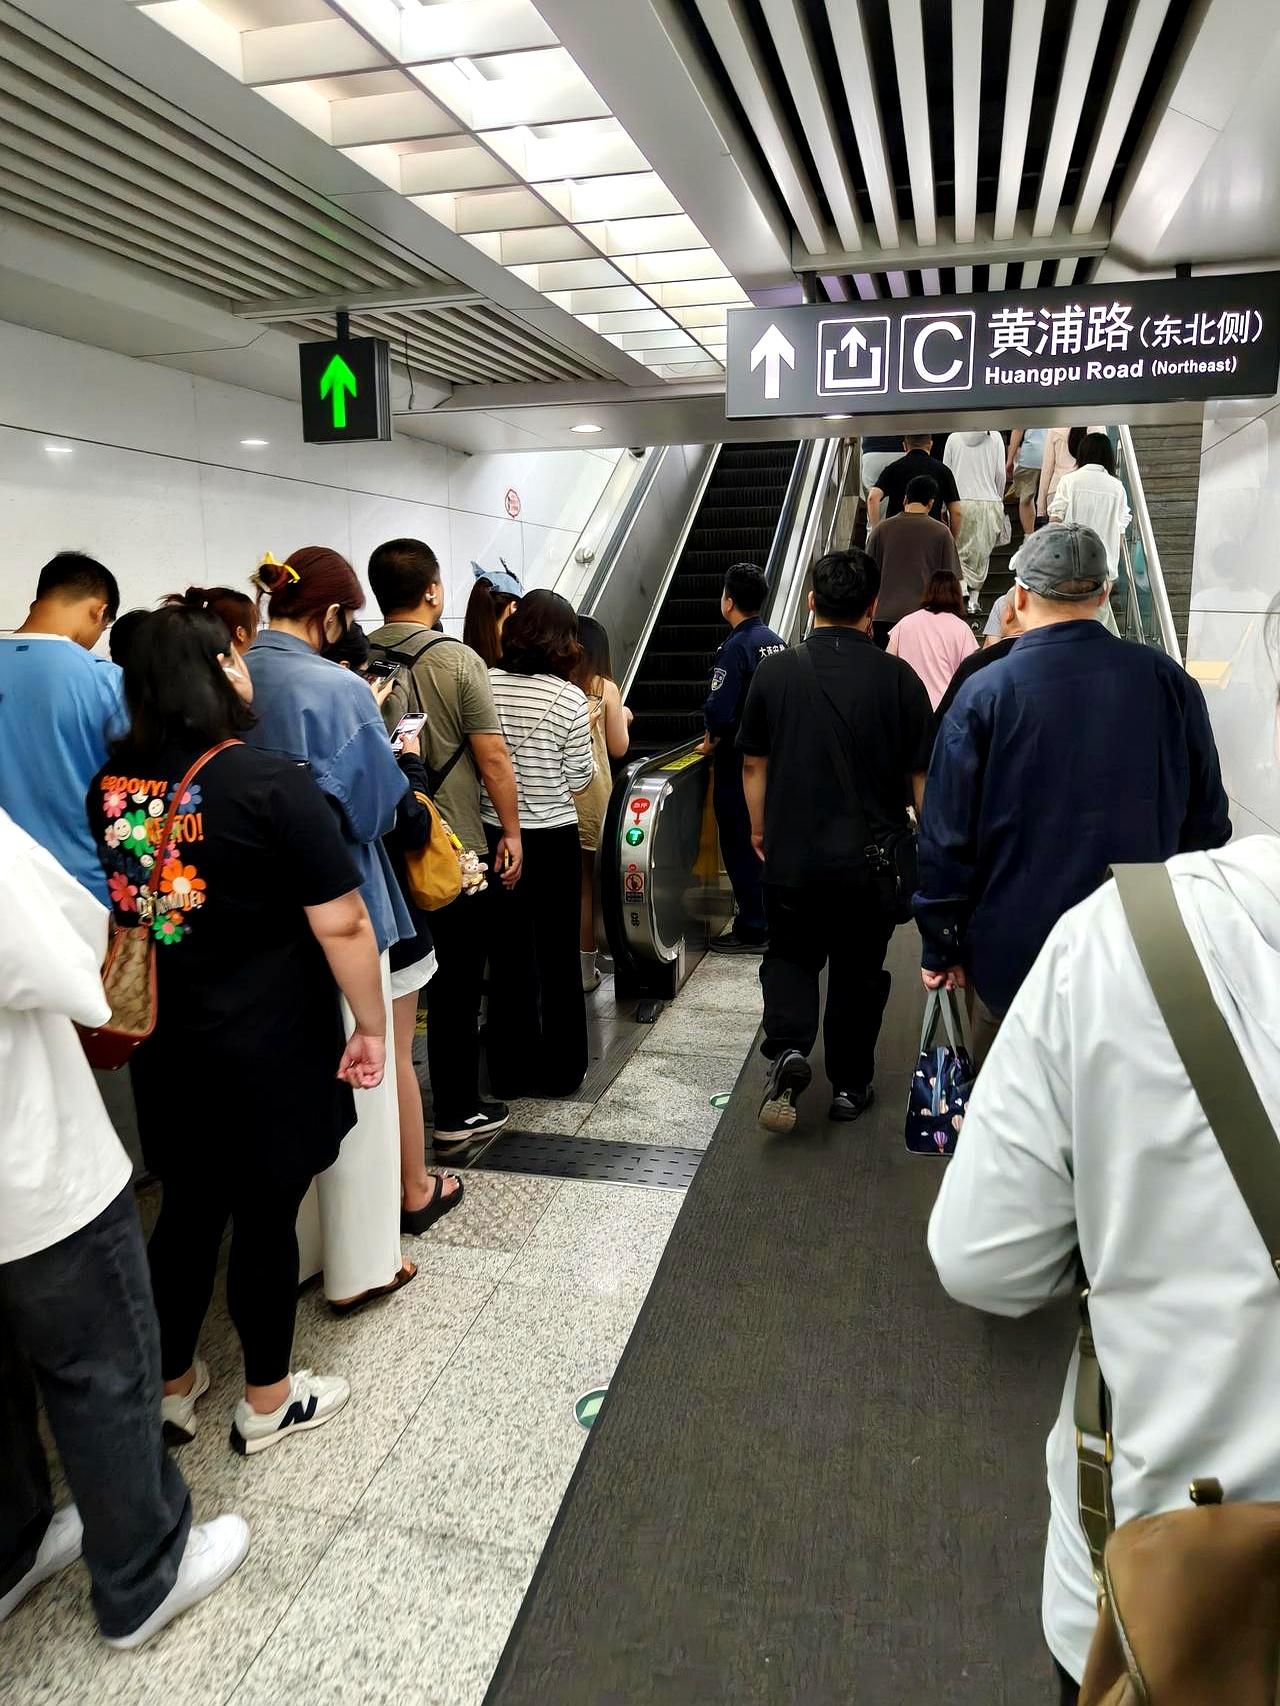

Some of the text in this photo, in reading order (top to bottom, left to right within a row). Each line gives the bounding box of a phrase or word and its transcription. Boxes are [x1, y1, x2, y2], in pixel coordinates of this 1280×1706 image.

[913, 321, 963, 384] C
[985, 355, 1237, 387] Huangpu Road (Northeast)
